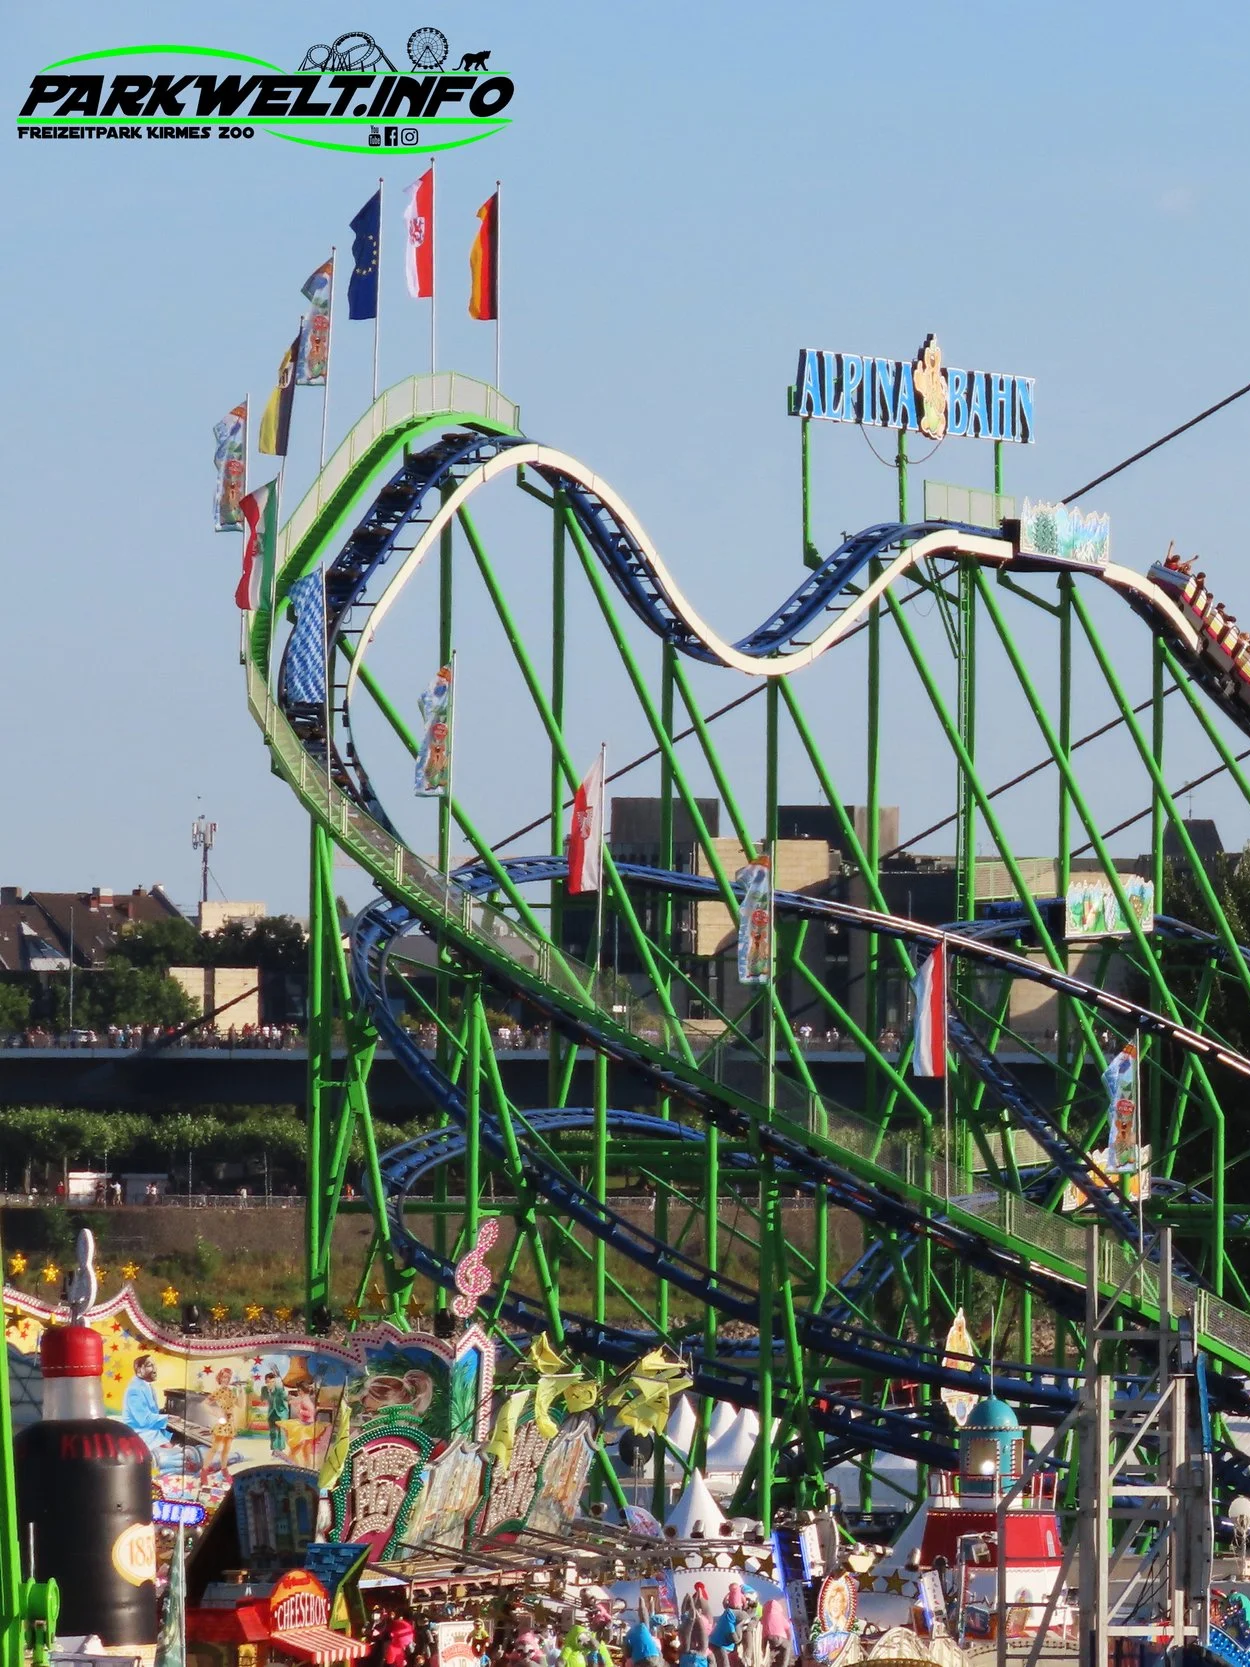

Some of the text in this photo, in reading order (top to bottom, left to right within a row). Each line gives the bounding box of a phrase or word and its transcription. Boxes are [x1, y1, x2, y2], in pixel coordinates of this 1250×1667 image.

[799, 348, 1036, 444] ALPINA BAHN
[278, 1591, 327, 1631] CHEESEBOX
